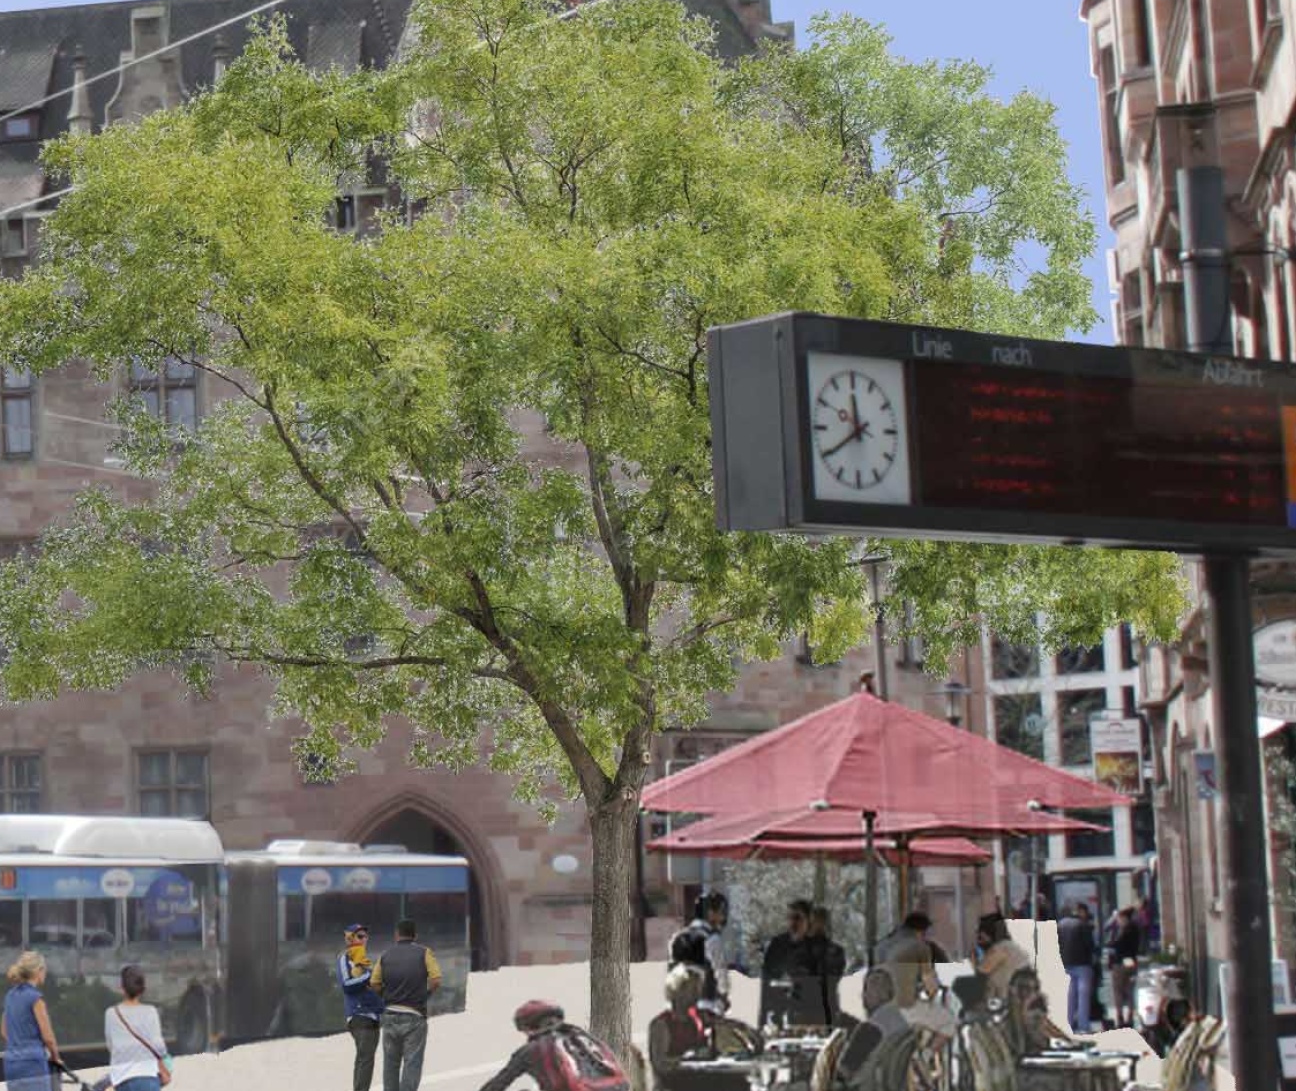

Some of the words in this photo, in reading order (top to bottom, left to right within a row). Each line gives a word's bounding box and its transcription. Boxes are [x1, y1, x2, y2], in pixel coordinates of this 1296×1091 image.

[912, 332, 953, 359] Linie
[992, 342, 1033, 367] nach
[1203, 359, 1265, 388] Abfahrt
